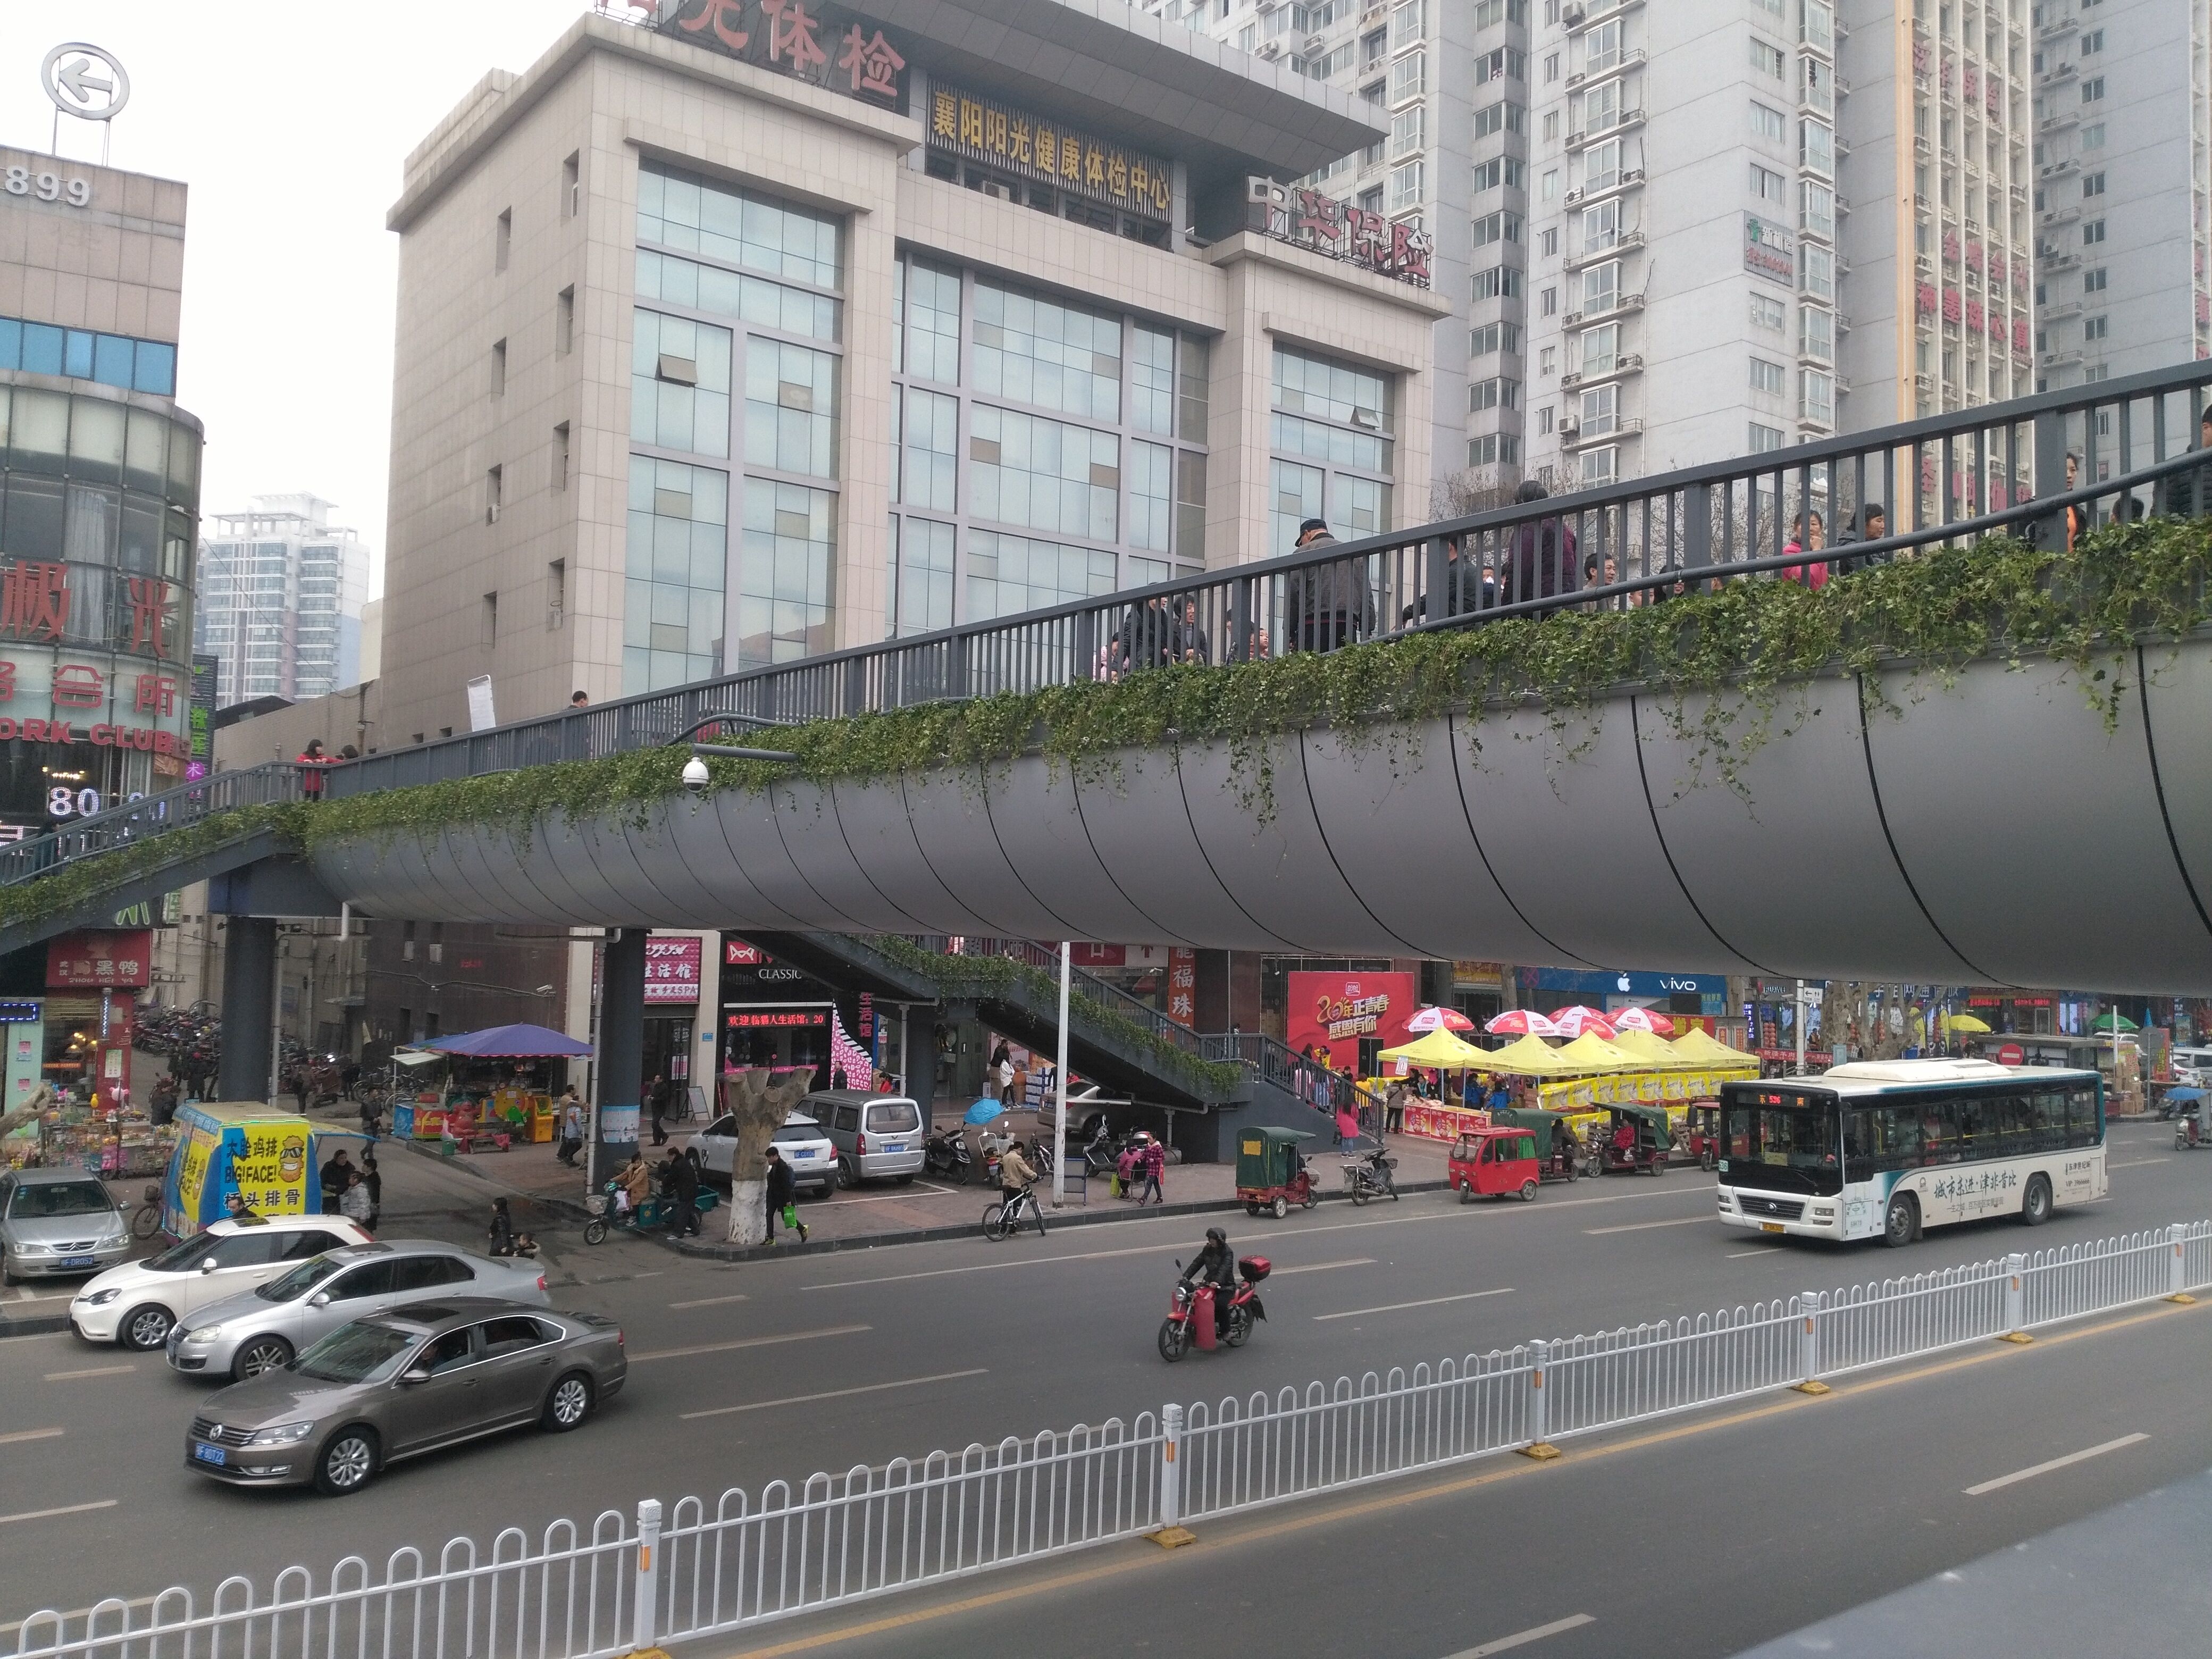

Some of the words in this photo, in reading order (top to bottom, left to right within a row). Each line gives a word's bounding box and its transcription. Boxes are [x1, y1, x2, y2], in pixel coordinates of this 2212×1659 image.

[593, 0, 905, 96] 光体检
[934, 90, 1170, 210] 襄阳阳光健康体检中心
[4, 165, 90, 207] 899
[1247, 176, 1434, 279] 中华保险
[90, 723, 174, 752] CLUB
[73, 960, 138, 976] 黑鸭
[759, 969, 802, 979] CLASSIC
[1173, 948, 1194, 1028] 福珠
[1660, 977, 1696, 991] vivo
[859, 992, 873, 1037] 生活馆
[1328, 1015, 1377, 1040] 感恩有你
[227, 1135, 278, 1161] 大脸鸡排
[224, 1164, 277, 1184] BIG!FACE!
